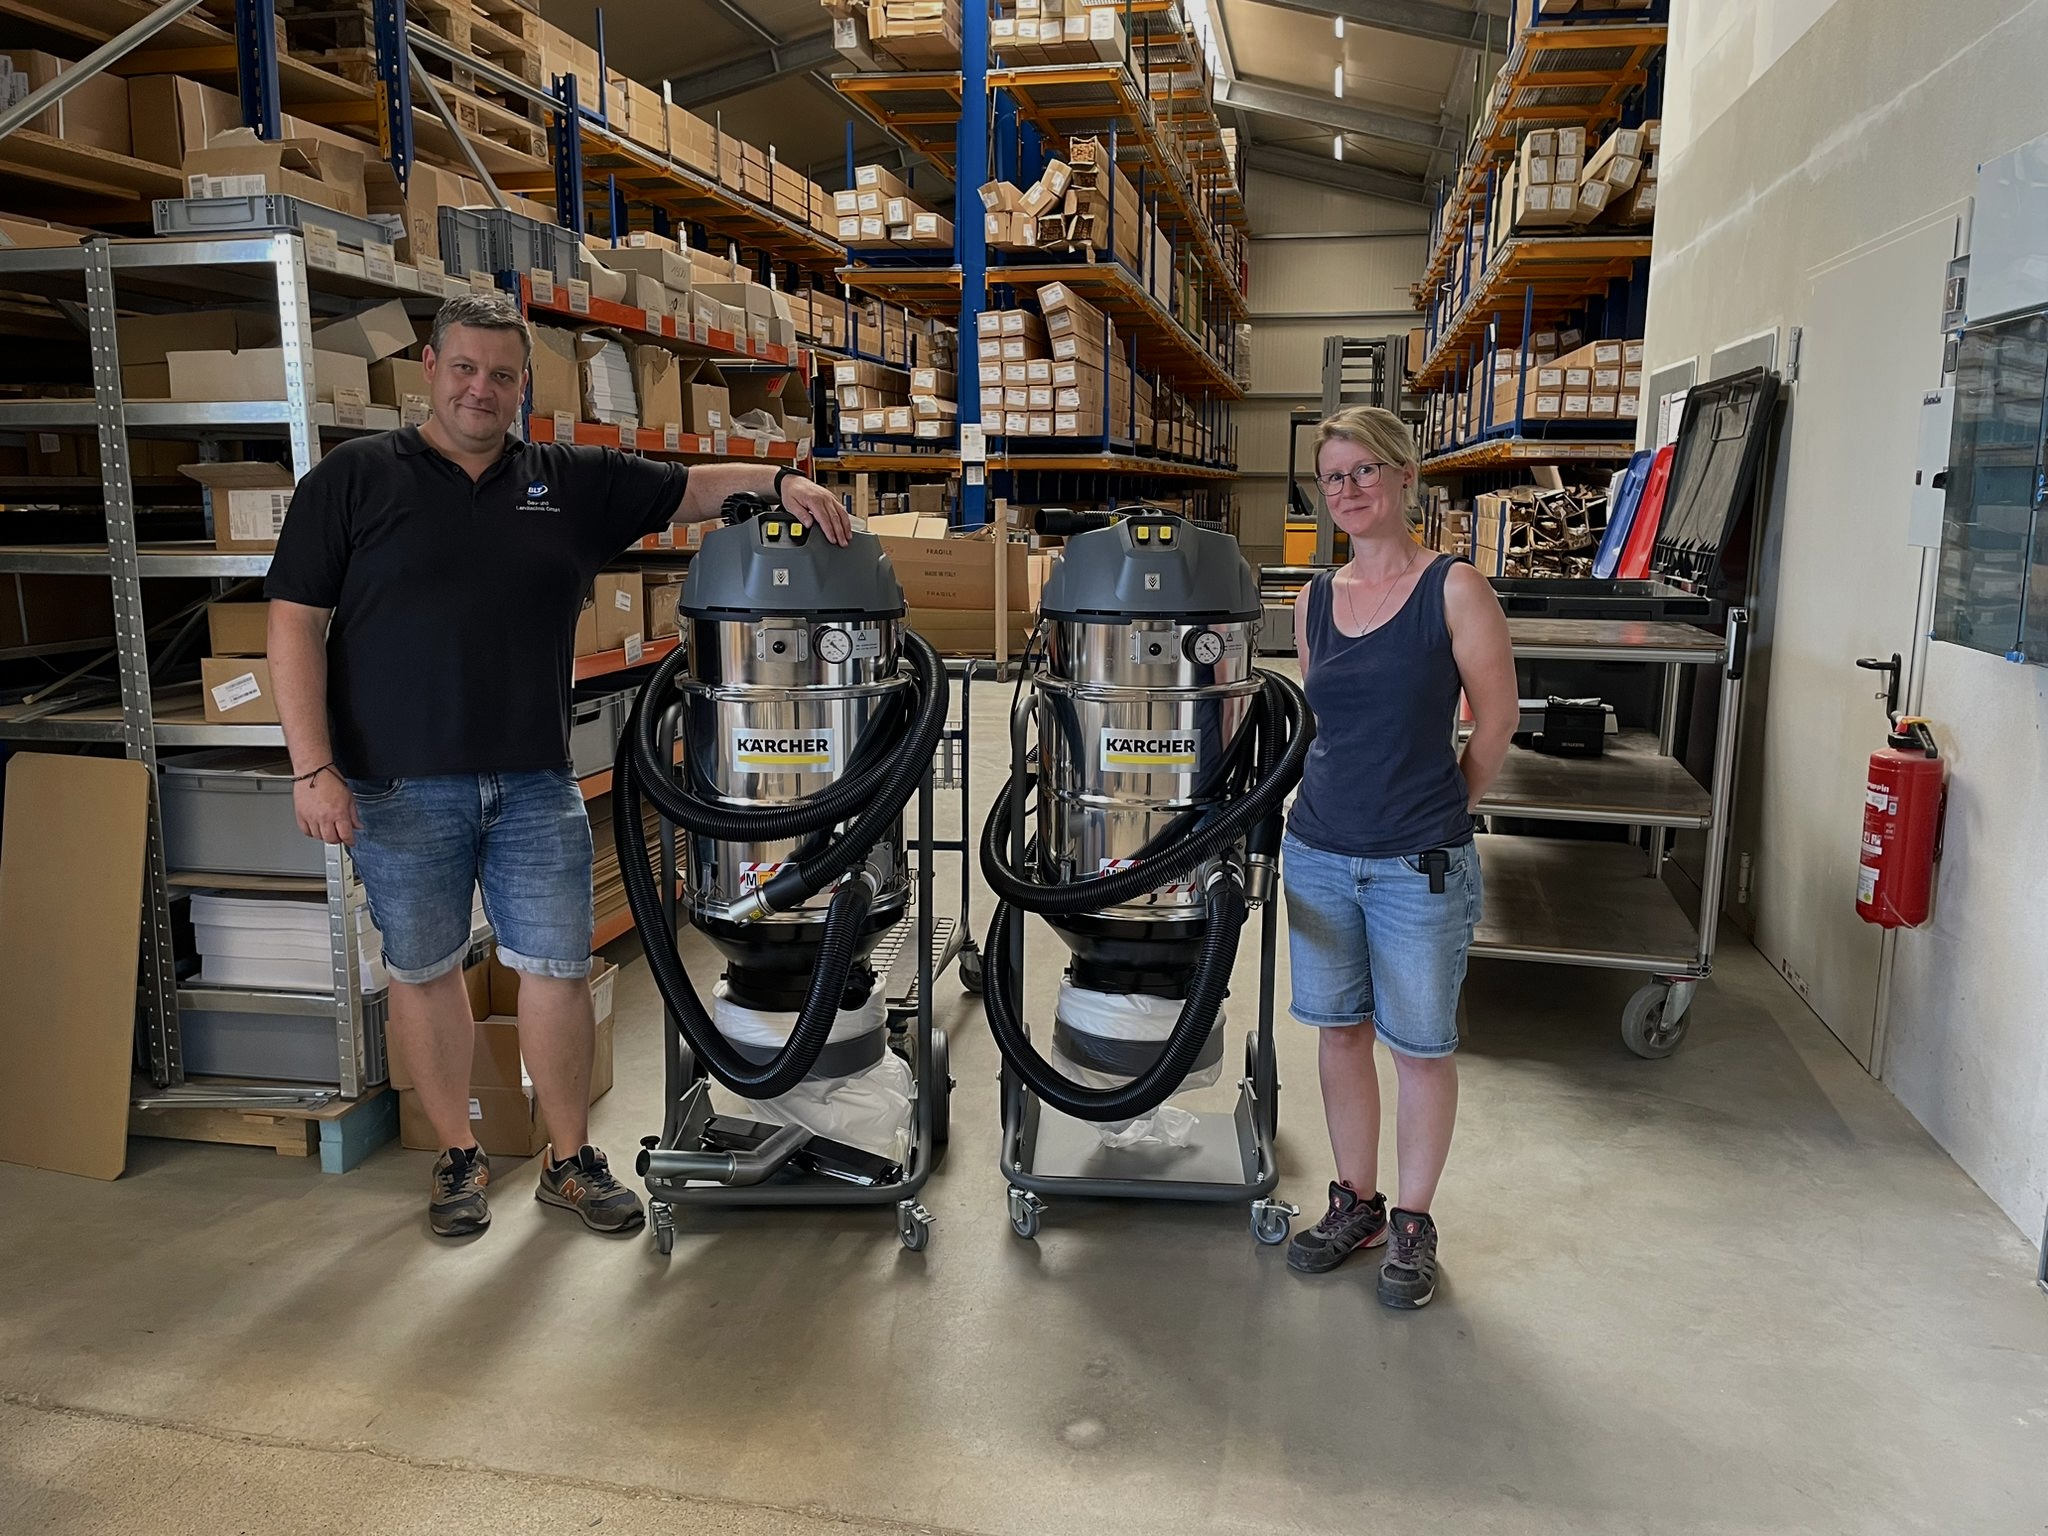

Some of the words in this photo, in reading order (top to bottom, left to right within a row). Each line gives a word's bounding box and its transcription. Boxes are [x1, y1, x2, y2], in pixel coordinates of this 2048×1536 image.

[737, 738, 829, 753] KÄRCHER
[1106, 738, 1196, 753] KÄRCHER
[746, 872, 757, 886] M
